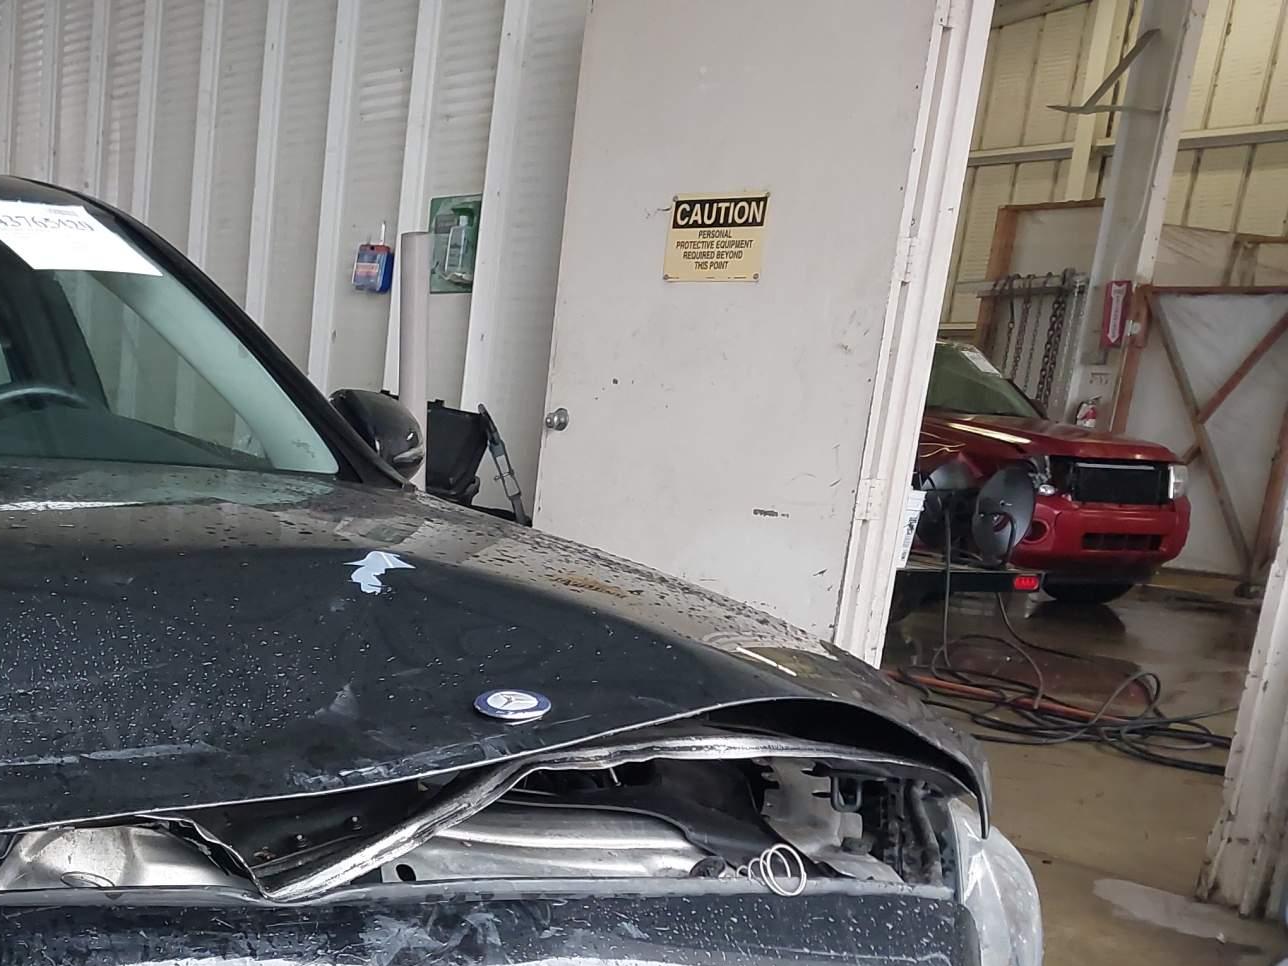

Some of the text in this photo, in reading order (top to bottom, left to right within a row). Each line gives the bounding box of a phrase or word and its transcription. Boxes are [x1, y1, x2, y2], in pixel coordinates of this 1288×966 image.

[677, 201, 764, 225] CAUTION
[698, 230, 732, 239] PERSONAL
[676, 239, 753, 249] PROTECTIVE EQUIPMENT
[683, 250, 743, 260] REQUIRED BEYOND
[694, 261, 728, 270] THIS POINT
